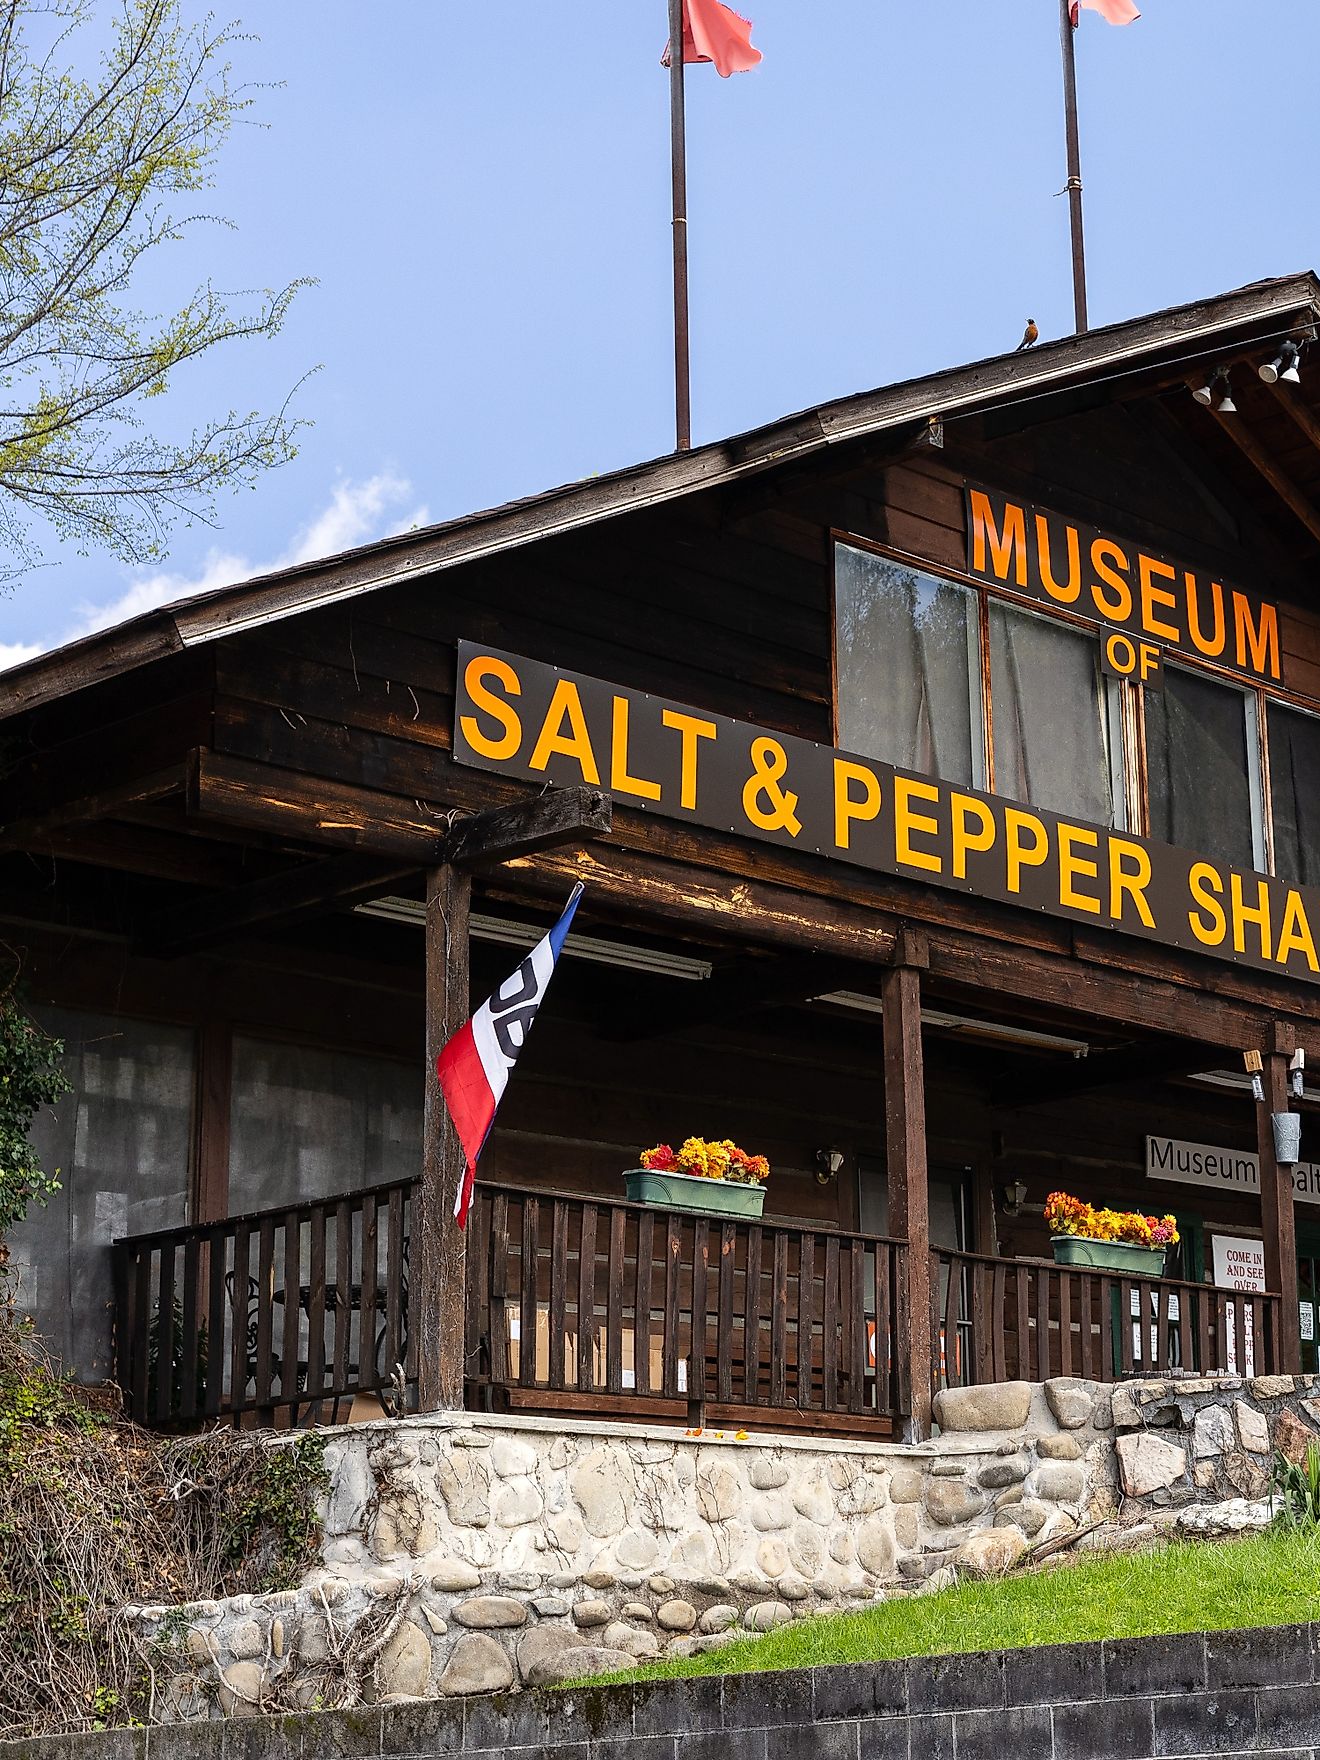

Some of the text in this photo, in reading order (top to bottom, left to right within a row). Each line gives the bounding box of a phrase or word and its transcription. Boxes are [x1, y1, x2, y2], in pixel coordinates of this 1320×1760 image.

[970, 490, 1281, 680] MUSEUM
[1106, 634, 1160, 681] OF
[460, 655, 717, 810] SALT
[743, 737, 802, 837] &
[833, 759, 1155, 929] PEPPER
[1150, 1139, 1257, 1184] Museum
[1226, 1250, 1262, 1265] COME IN
[1226, 1264, 1264, 1280] AND SEE
[1234, 1280, 1257, 1291] OVER
